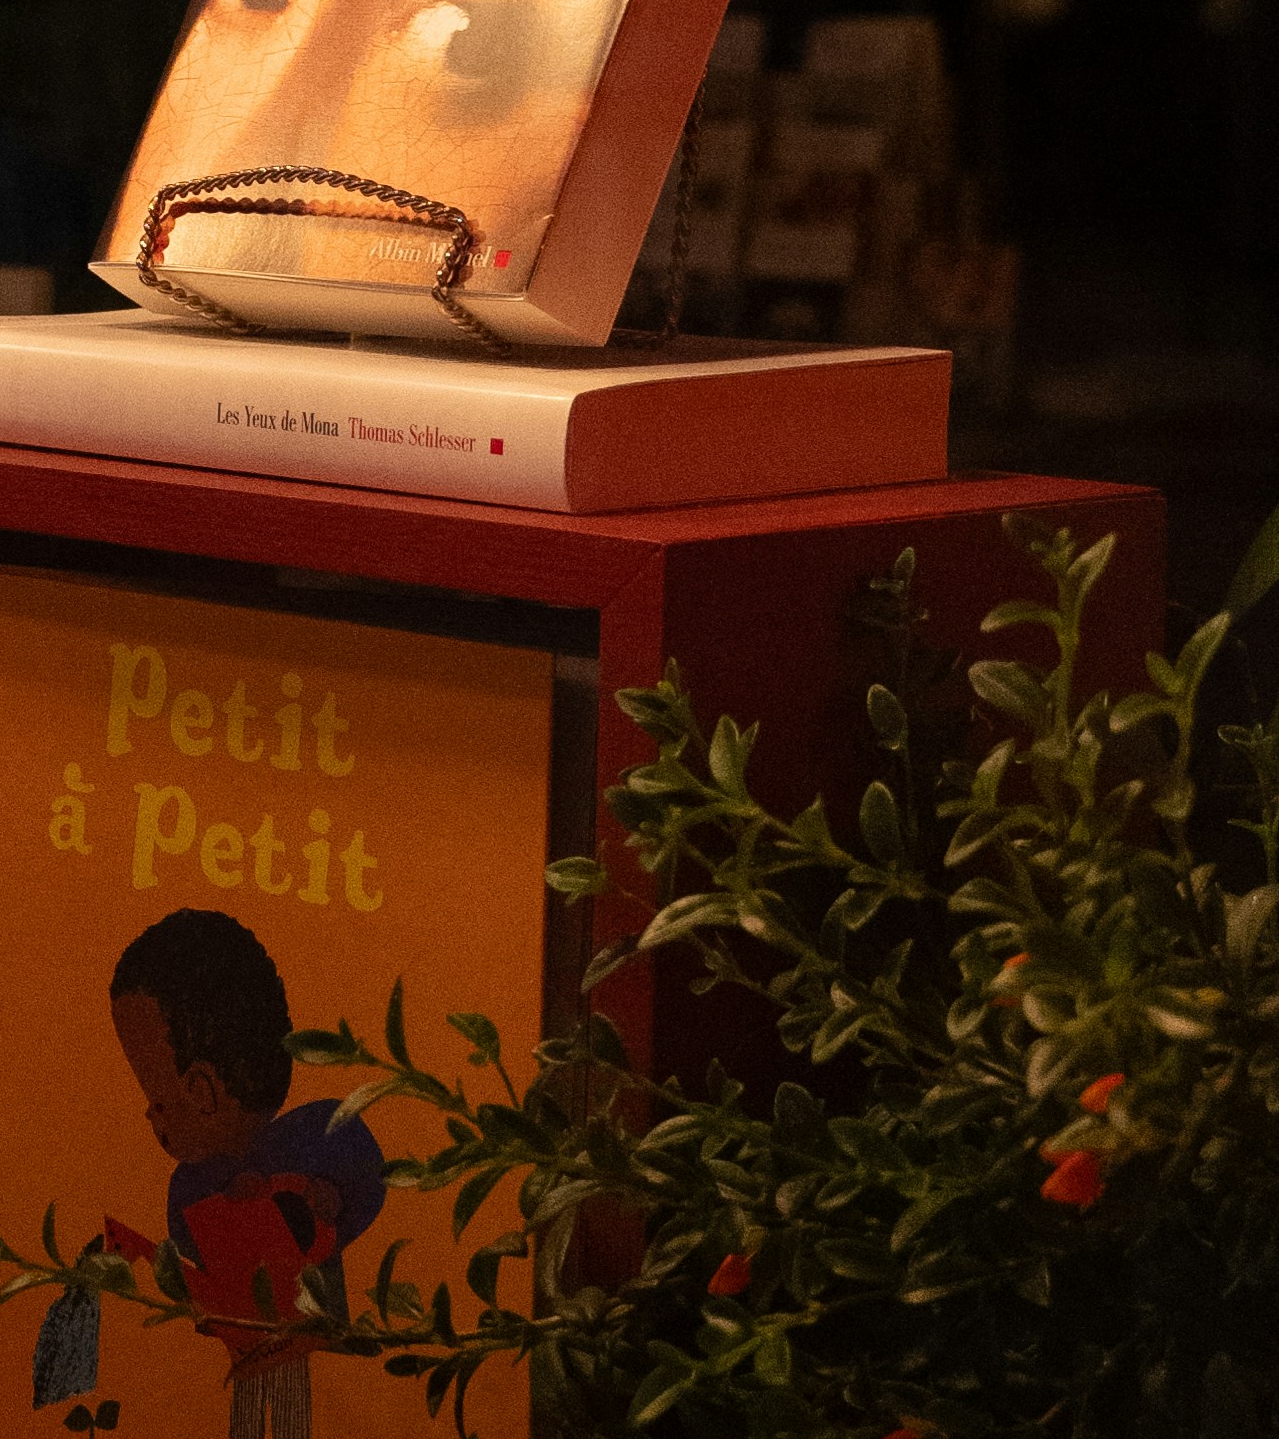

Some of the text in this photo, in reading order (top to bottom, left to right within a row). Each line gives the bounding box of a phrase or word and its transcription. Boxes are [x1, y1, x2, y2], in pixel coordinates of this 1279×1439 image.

[369, 237, 422, 261] Albin
[215, 401, 477, 454] Les Yeux de Mona Thomas Schlesser
[105, 641, 357, 779] Petit
[48, 761, 384, 912] à Petit
